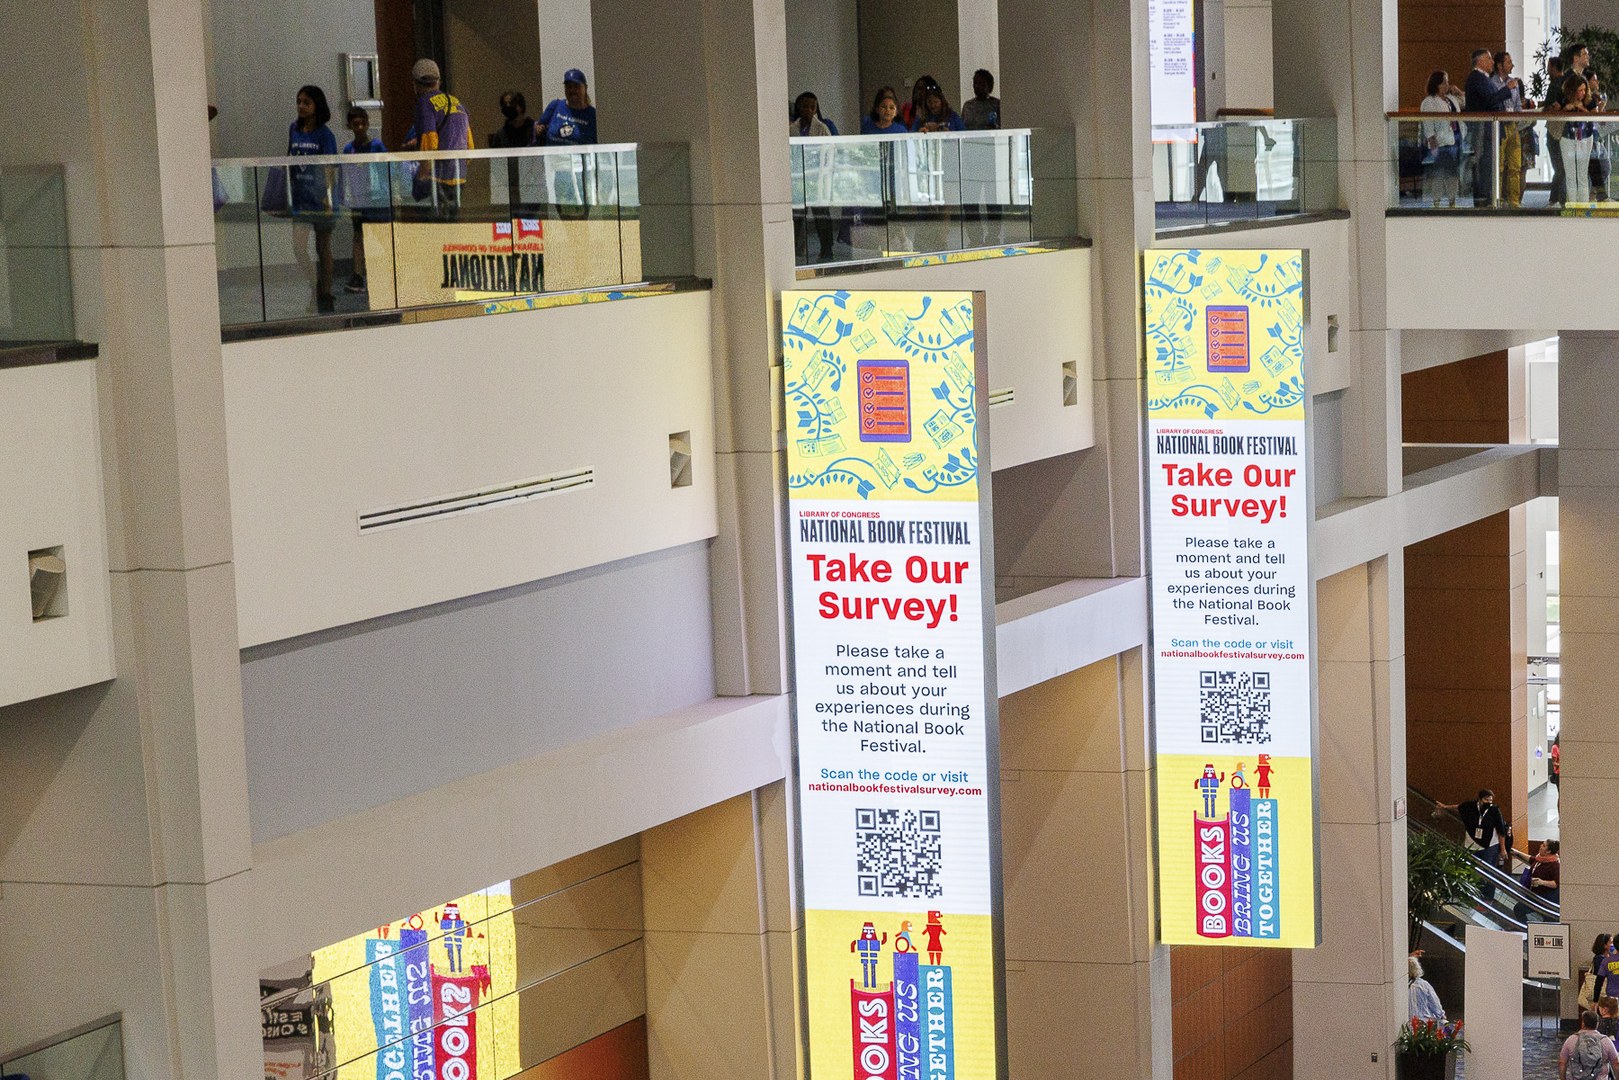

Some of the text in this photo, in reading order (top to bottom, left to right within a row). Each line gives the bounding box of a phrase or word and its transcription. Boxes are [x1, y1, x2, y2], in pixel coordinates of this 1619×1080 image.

[1157, 435, 1298, 456] NATIONAL BOOK FESTIVAL
[1162, 463, 1296, 488] Take Our
[1171, 494, 1287, 524] Survey!
[800, 519, 971, 545] NATIONAL BOOK FESTIVAL
[806, 553, 969, 584] Take Our
[818, 591, 959, 629] Survey!
[836, 645, 945, 659] Please take a
[1161, 650, 1305, 661] nationalbookfestivalsurvey.com
[825, 665, 957, 679] moment and tell
[836, 683, 947, 699] us about your
[815, 702, 970, 720] experiences during
[822, 719, 964, 736] the National Book
[860, 739, 927, 754] Festival.
[821, 768, 969, 783] Scan the code or visit
[808, 782, 982, 797] nationalbookfestivalsurvey.com
[1232, 811, 1251, 935] BRING US
[1257, 801, 1274, 936] TOGETHER
[1201, 825, 1226, 934] BOOKS
[898, 980, 919, 1019] US
